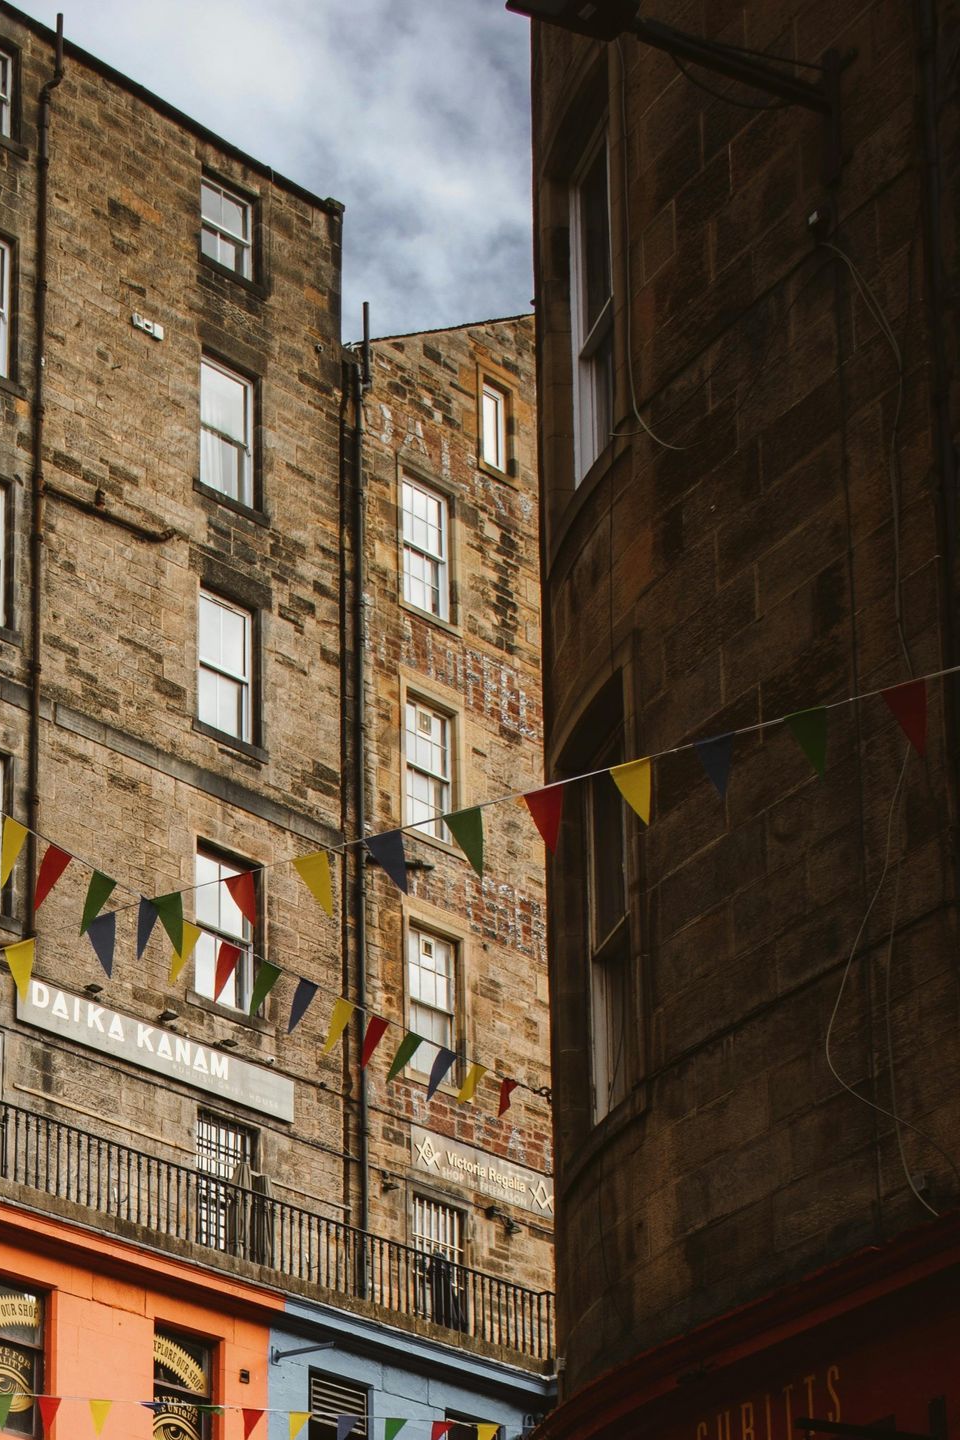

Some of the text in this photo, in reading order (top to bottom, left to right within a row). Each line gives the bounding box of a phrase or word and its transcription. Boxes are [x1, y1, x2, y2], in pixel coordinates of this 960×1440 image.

[31, 980, 230, 1081] DAIKA KANAM
[441, 1167, 465, 1183] SHOP
[446, 1151, 526, 1193] Victoria Regalia
[1, 1303, 18, 1318] OUR
[18, 1303, 39, 1319] SHOP
[12, 1351, 32, 1370] FOR
[153, 1340, 204, 1392] XPLORE OUR SHOP
[168, 1404, 197, 1425] UNIQUE
